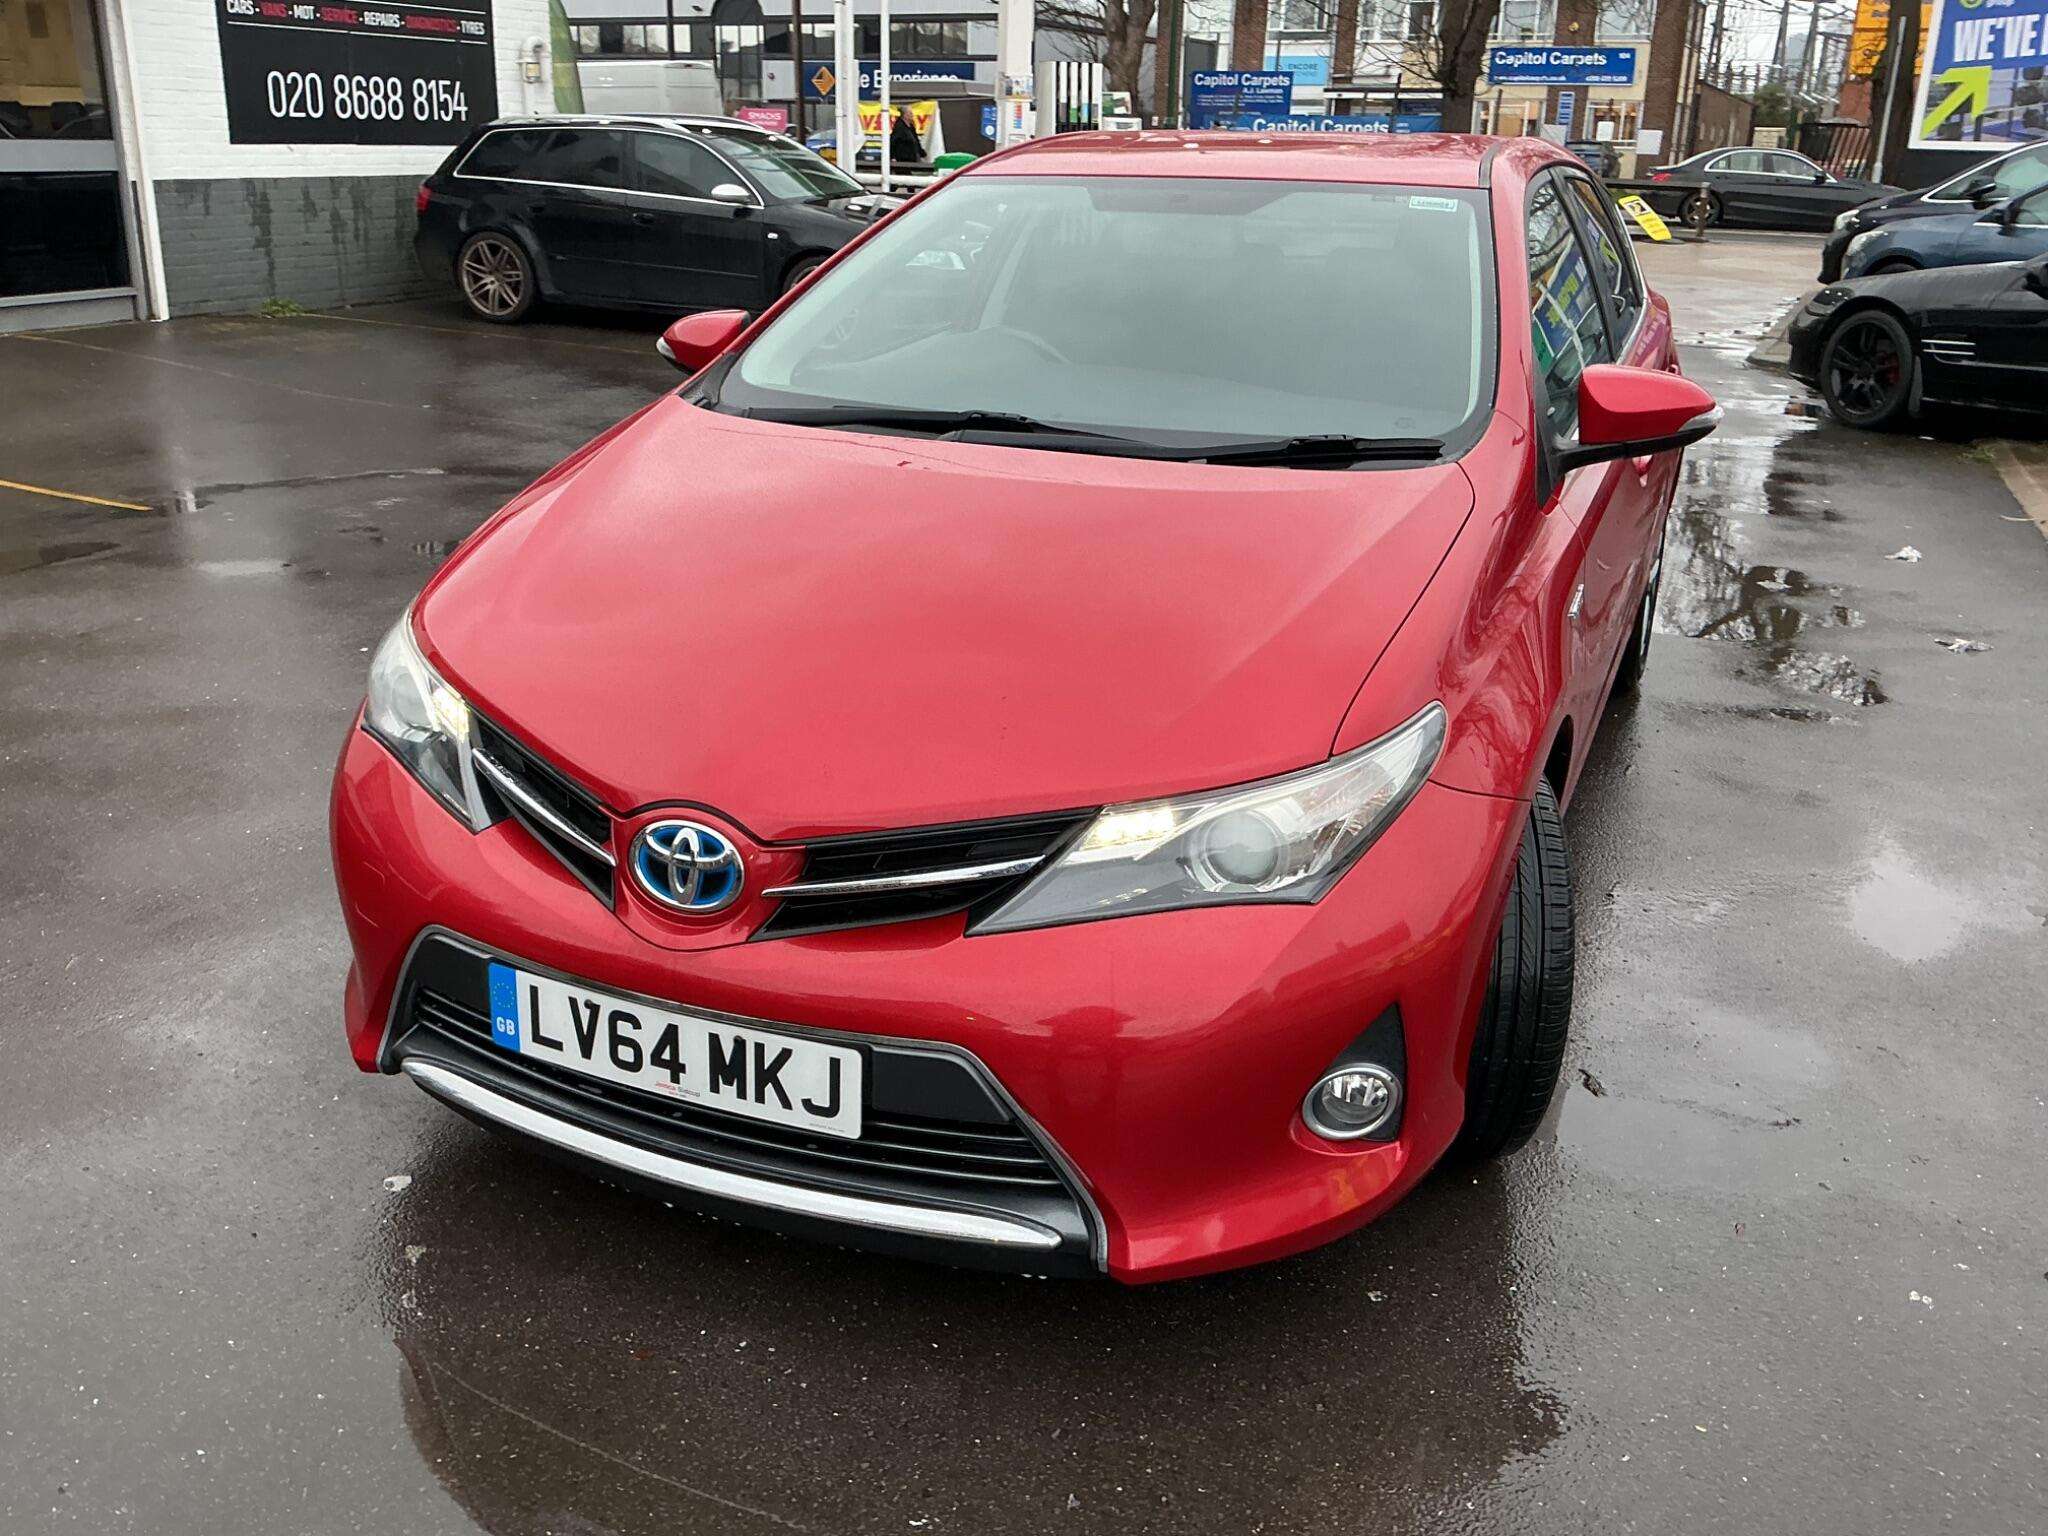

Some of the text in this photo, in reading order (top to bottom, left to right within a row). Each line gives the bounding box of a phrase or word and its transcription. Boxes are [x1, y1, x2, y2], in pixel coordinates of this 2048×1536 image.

[226, 0, 254, 15] CARS
[293, 5, 314, 19] MOT
[364, 11, 399, 27] REPAIRS
[461, 20, 485, 35] TYRES
[1954, 14, 2040, 62] WE'VE
[1495, 52, 1608, 67] Capitol Carpets
[1194, 74, 1238, 87] Capitol
[1241, 74, 1290, 88] Carpets
[267, 71, 468, 122] 020 8688 8154
[1253, 119, 1315, 132] Capitol
[1320, 119, 1389, 132] Carpets
[496, 1017, 515, 1036] GB
[530, 985, 841, 1118] LV64 MKJ
